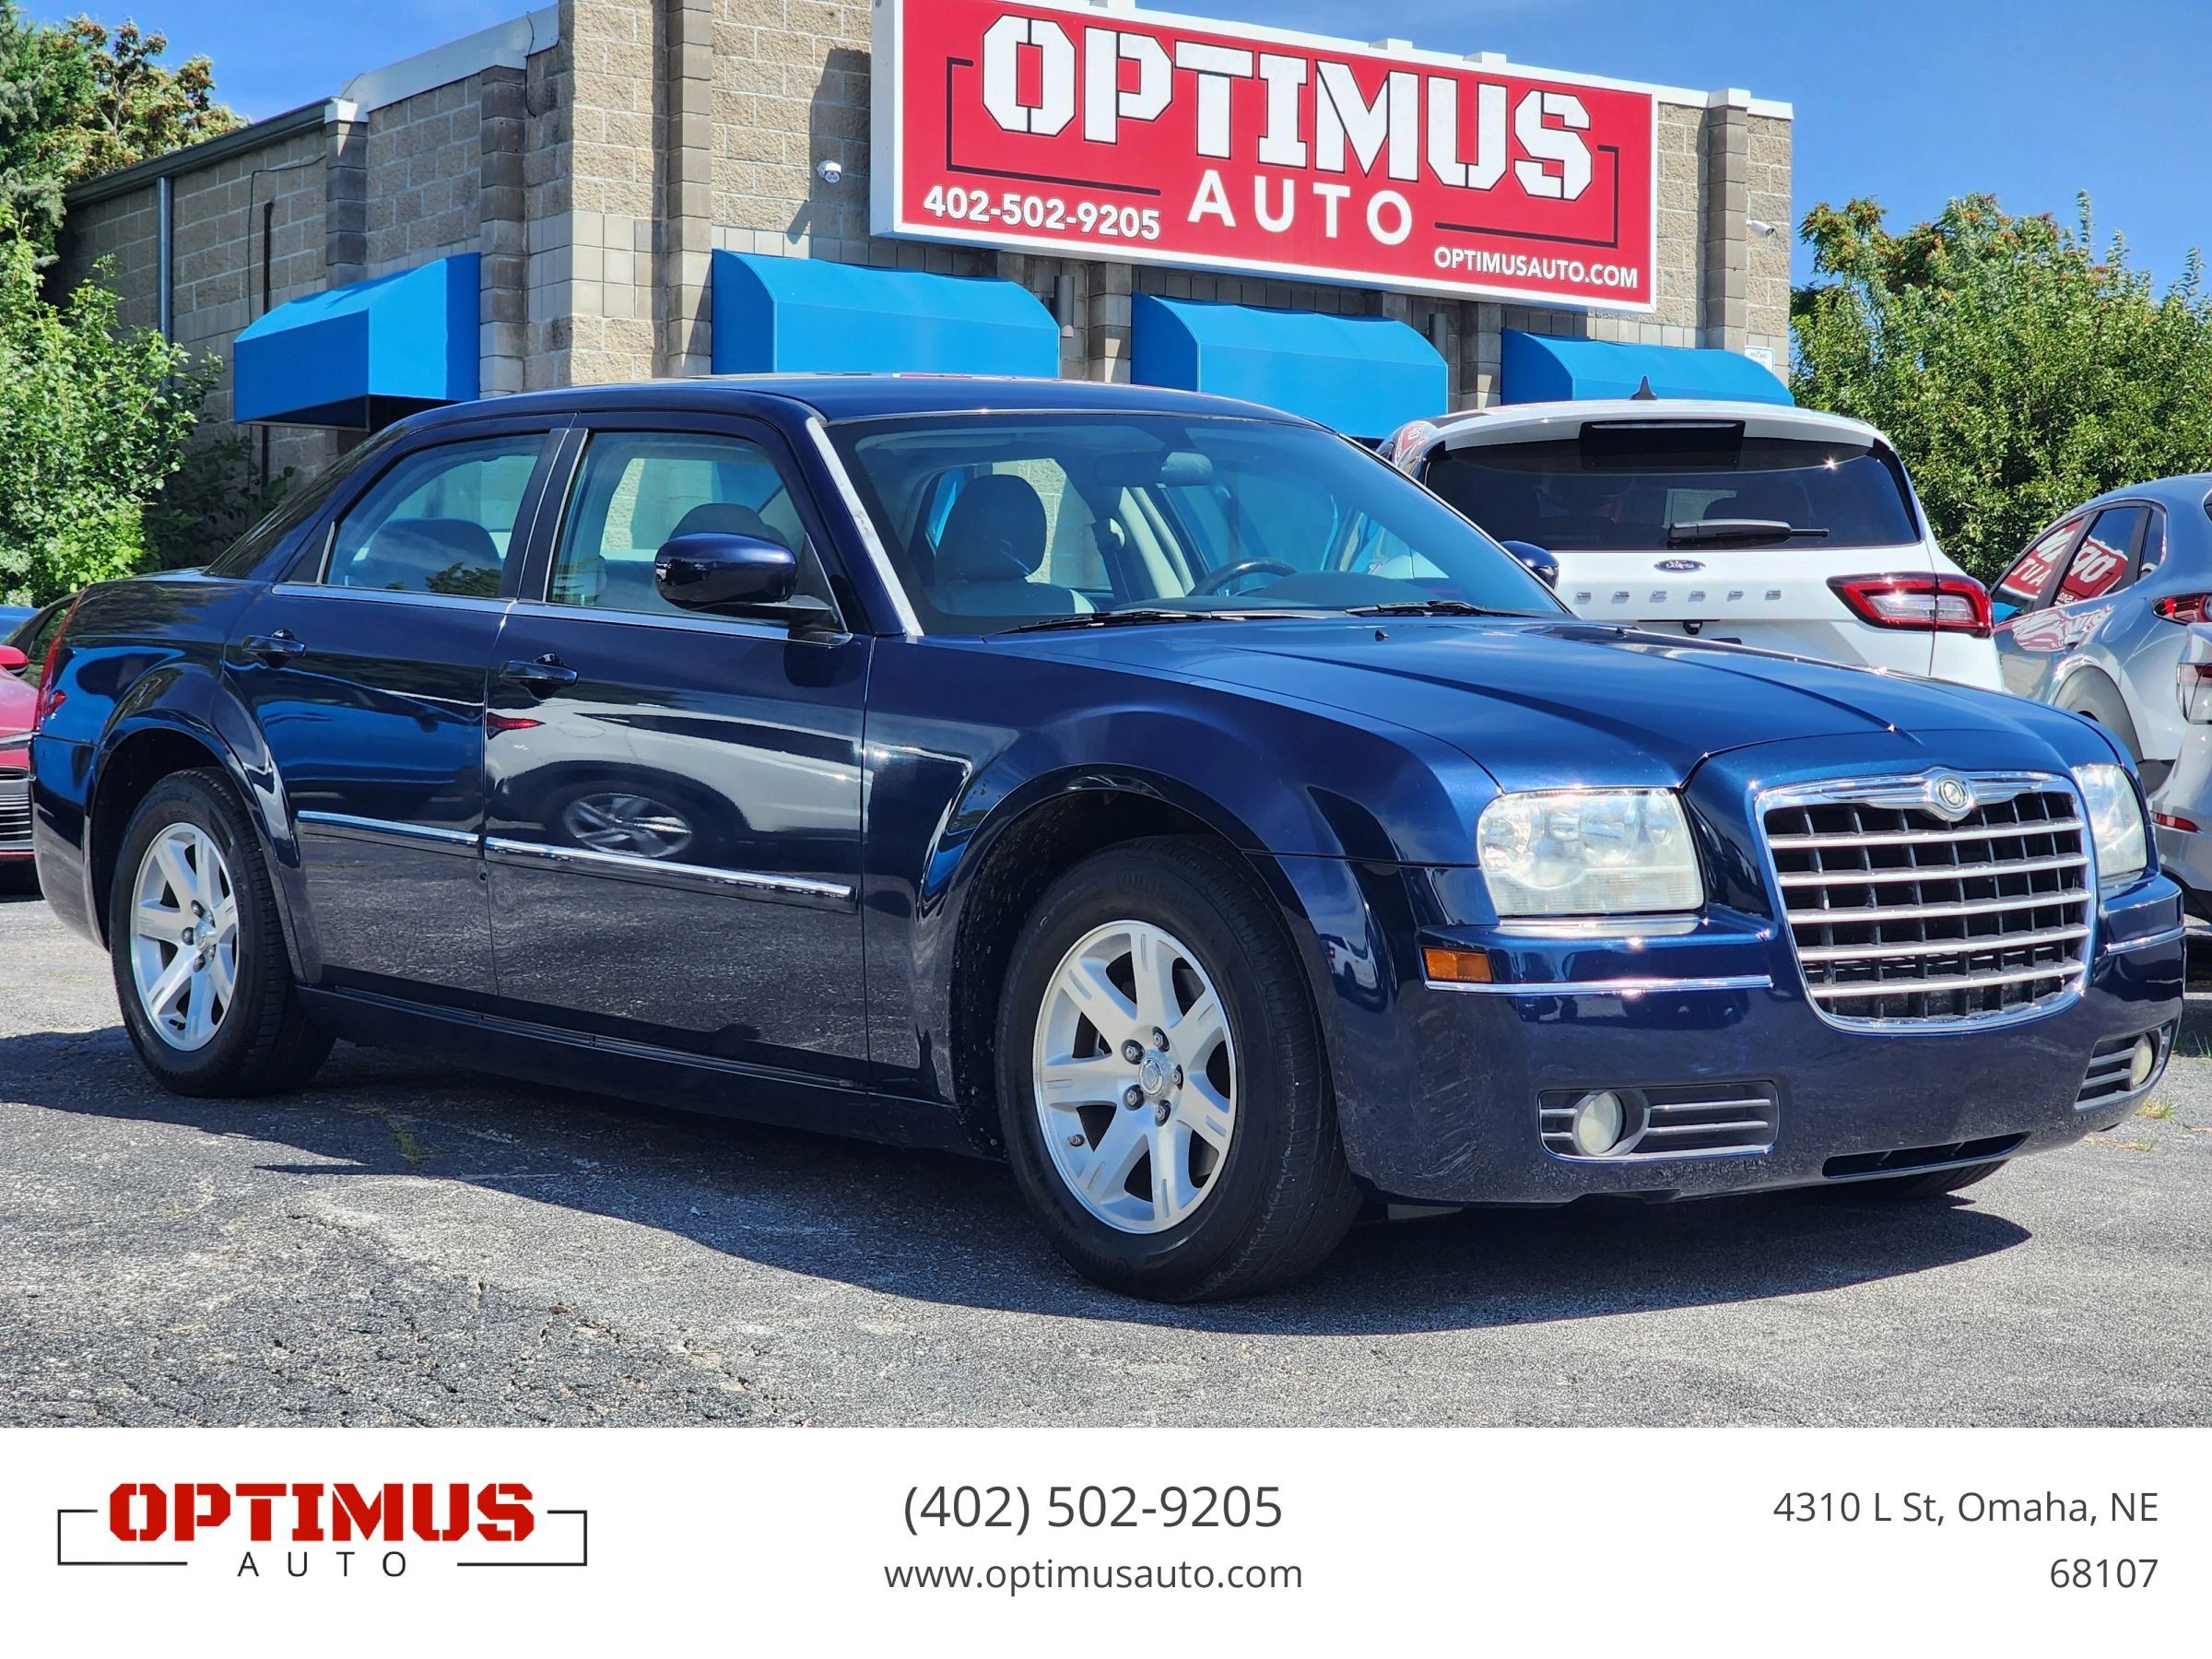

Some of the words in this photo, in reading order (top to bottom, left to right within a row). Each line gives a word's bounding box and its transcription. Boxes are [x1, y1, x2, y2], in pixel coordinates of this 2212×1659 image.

[982, 14, 1593, 201] OPTIMUS
[923, 184, 1161, 241] 402-502-9205
[1187, 169, 1414, 247] AUTO
[1432, 245, 1639, 290] OPTIMUSAUTO.COM
